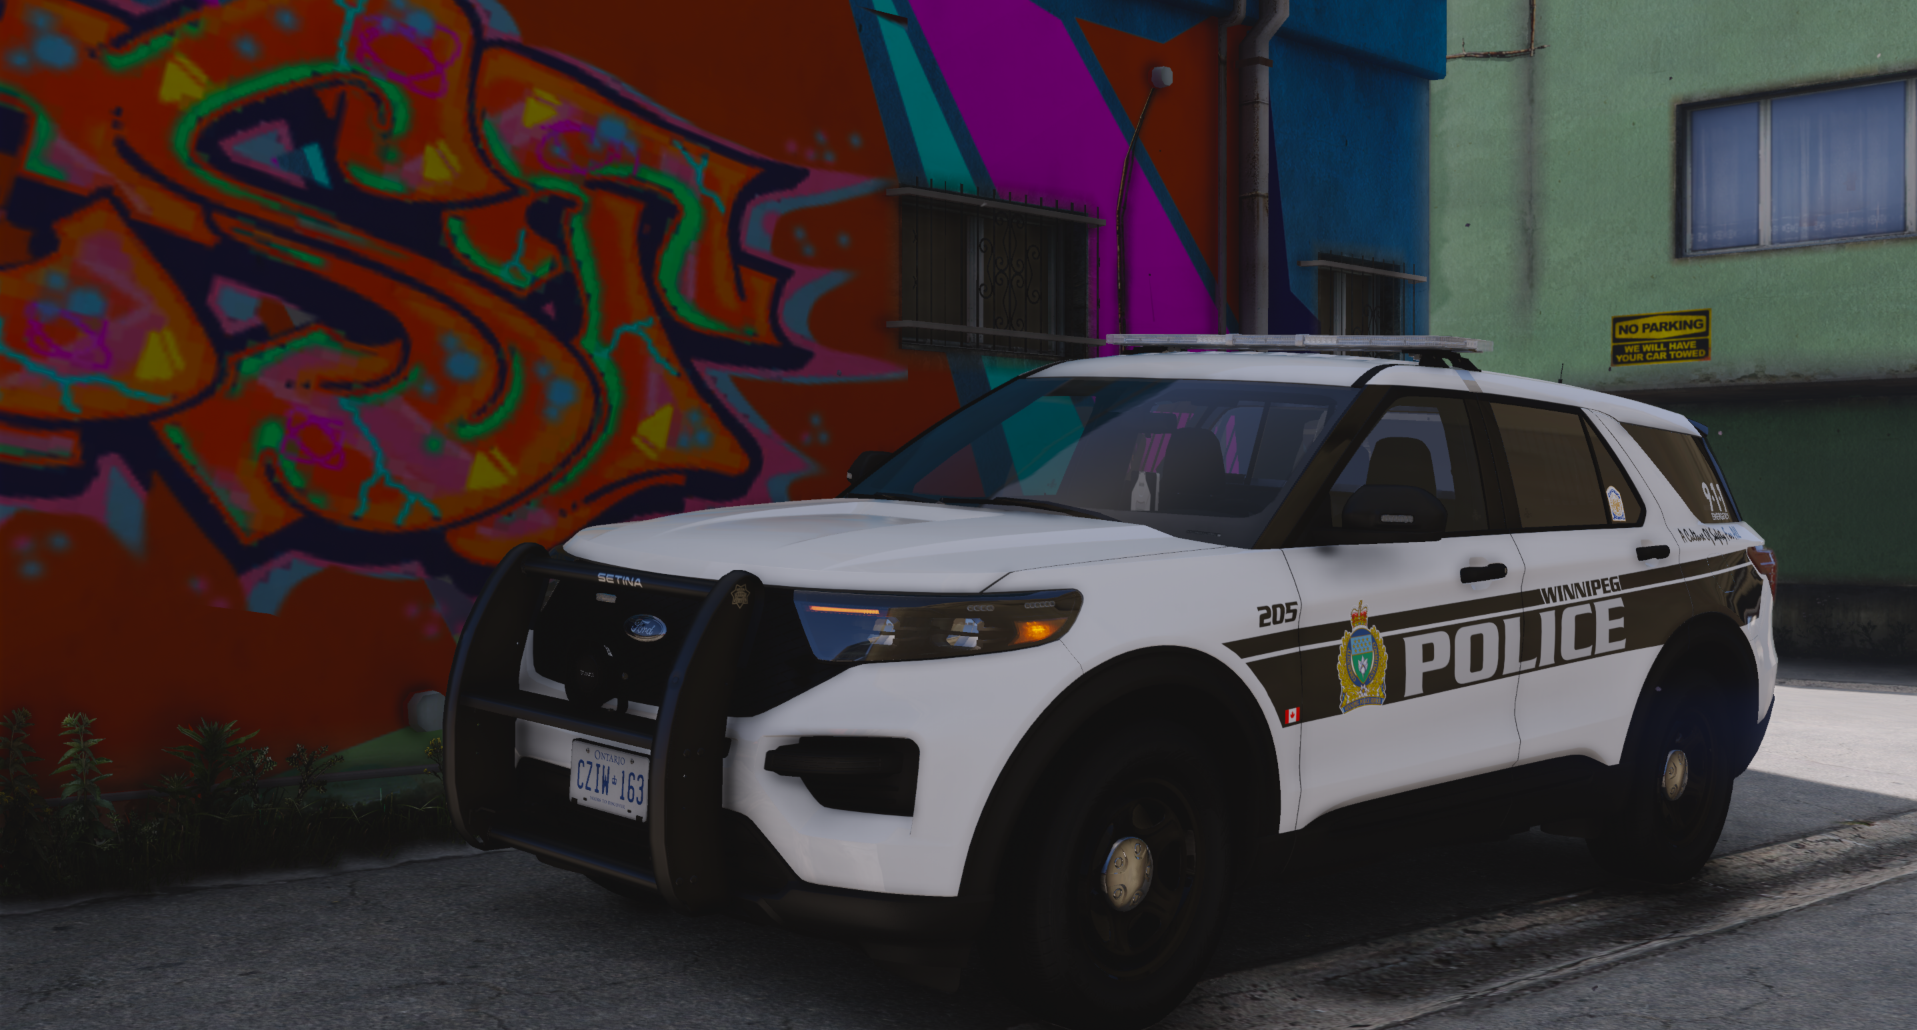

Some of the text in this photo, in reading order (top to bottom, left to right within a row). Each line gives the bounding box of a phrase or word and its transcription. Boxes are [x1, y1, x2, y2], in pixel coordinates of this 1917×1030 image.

[1618, 319, 1704, 335] NO PARKING
[1616, 349, 1706, 362] YOUR CAR TOWED
[1624, 341, 1697, 353] WE WILL HAVE
[597, 572, 643, 588] SETINA
[1541, 576, 1622, 604] WINNIPEG
[1257, 601, 1298, 628] 205
[630, 619, 656, 636] Ford
[1403, 597, 1627, 698] POLICE
[594, 749, 626, 766] ONTARIO
[577, 759, 645, 806] CZIW 163
